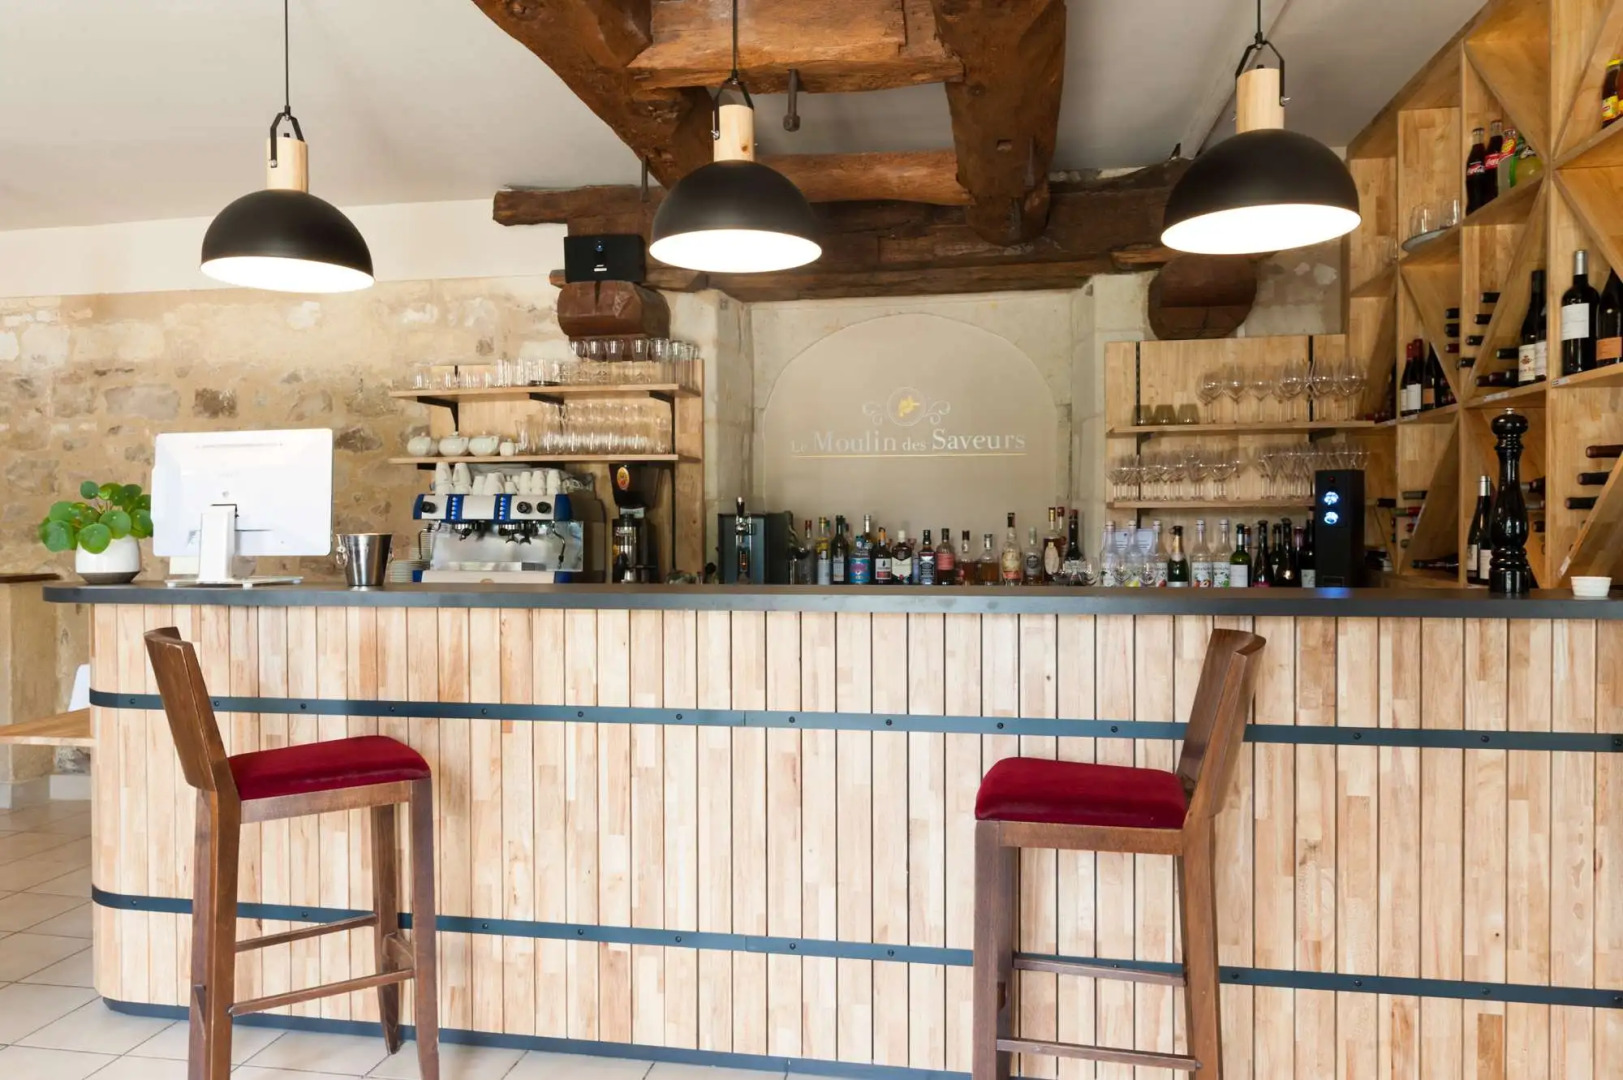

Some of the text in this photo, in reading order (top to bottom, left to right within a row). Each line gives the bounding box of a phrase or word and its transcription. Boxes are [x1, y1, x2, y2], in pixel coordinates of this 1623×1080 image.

[813, 430, 896, 452] Moulin
[902, 436, 926, 451] des
[932, 428, 1025, 450] Saveurs
